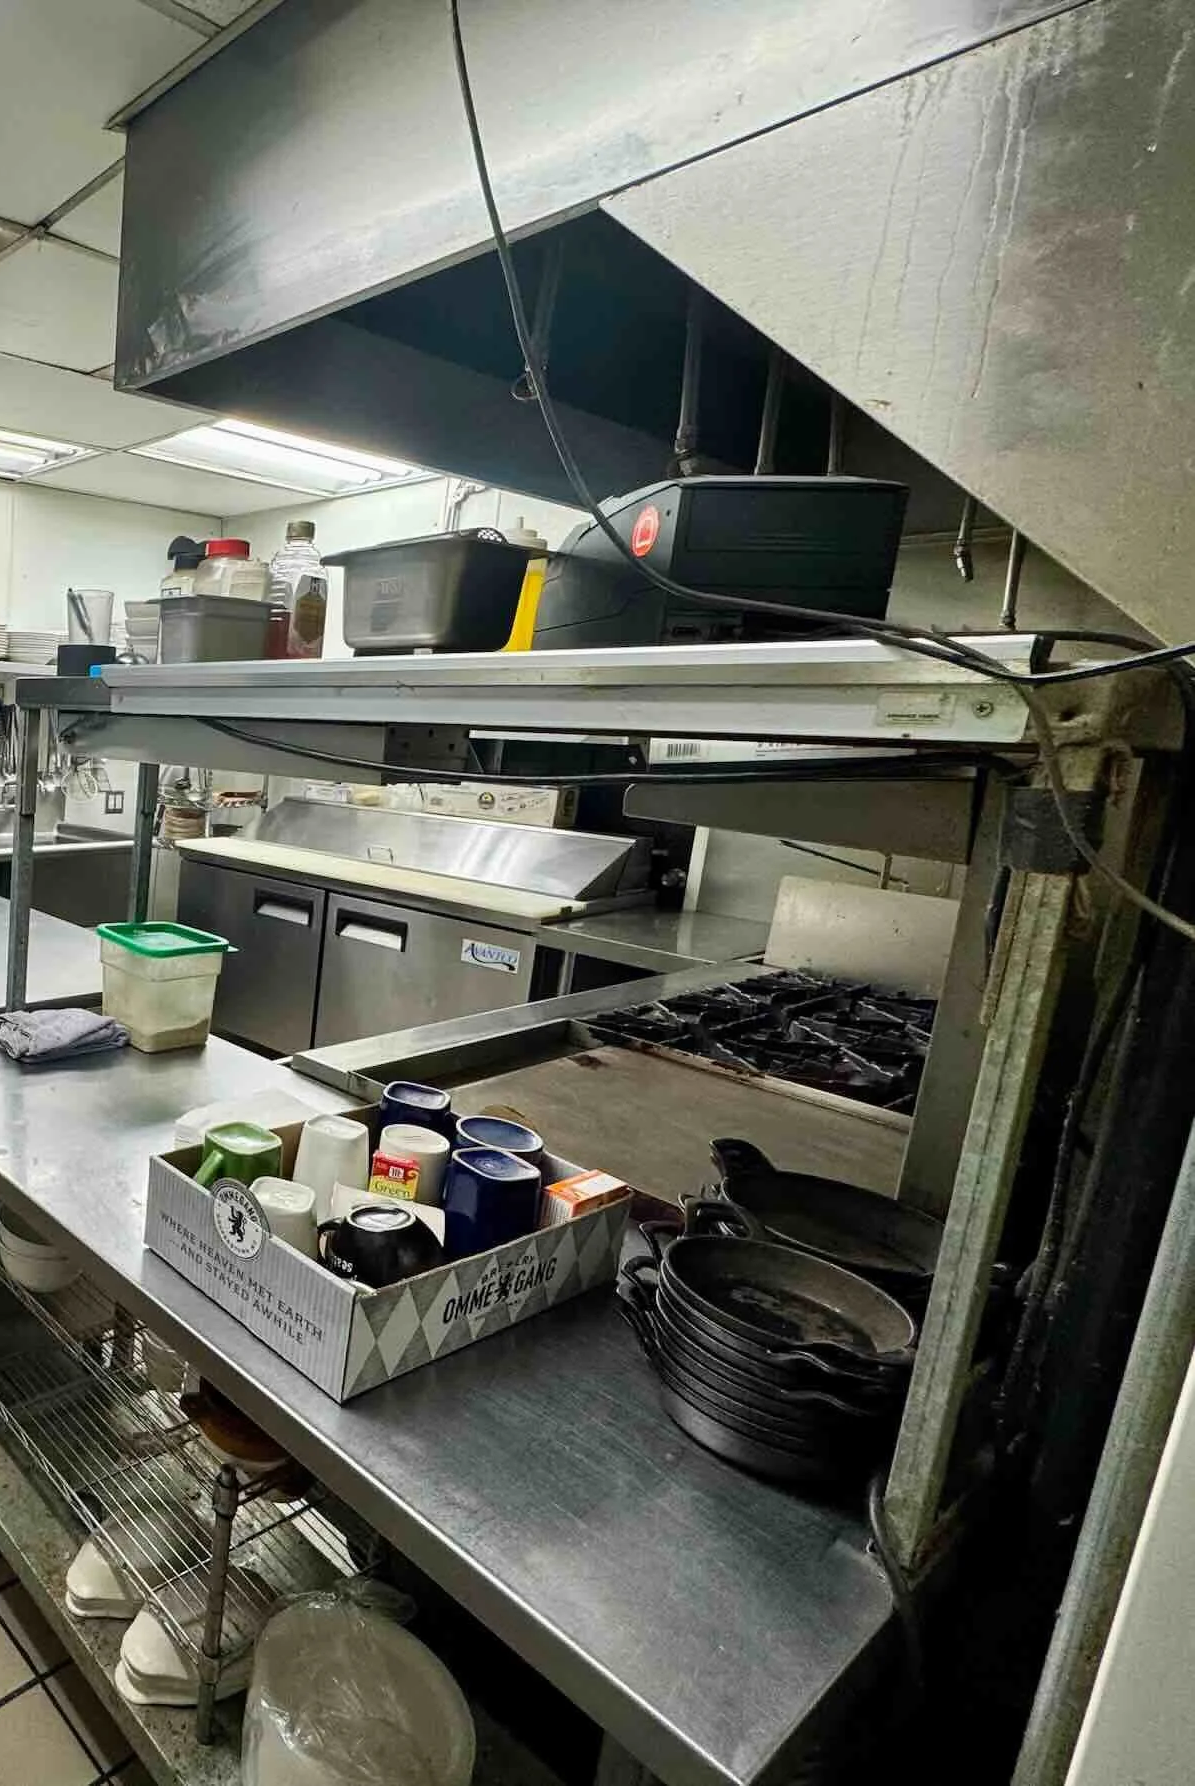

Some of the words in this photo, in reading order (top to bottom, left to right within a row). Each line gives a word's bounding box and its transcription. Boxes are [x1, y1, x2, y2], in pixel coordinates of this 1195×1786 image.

[375, 1181, 411, 1198] Green
[160, 1213, 197, 1246] WHERE
[199, 1239, 245, 1281] HEAVEN
[248, 1275, 274, 1303] MET
[277, 1299, 323, 1342] EARTH
[481, 1254, 534, 1285] BRERY
[205, 1261, 249, 1302] STAYED
[253, 1299, 304, 1345] AWHILE
